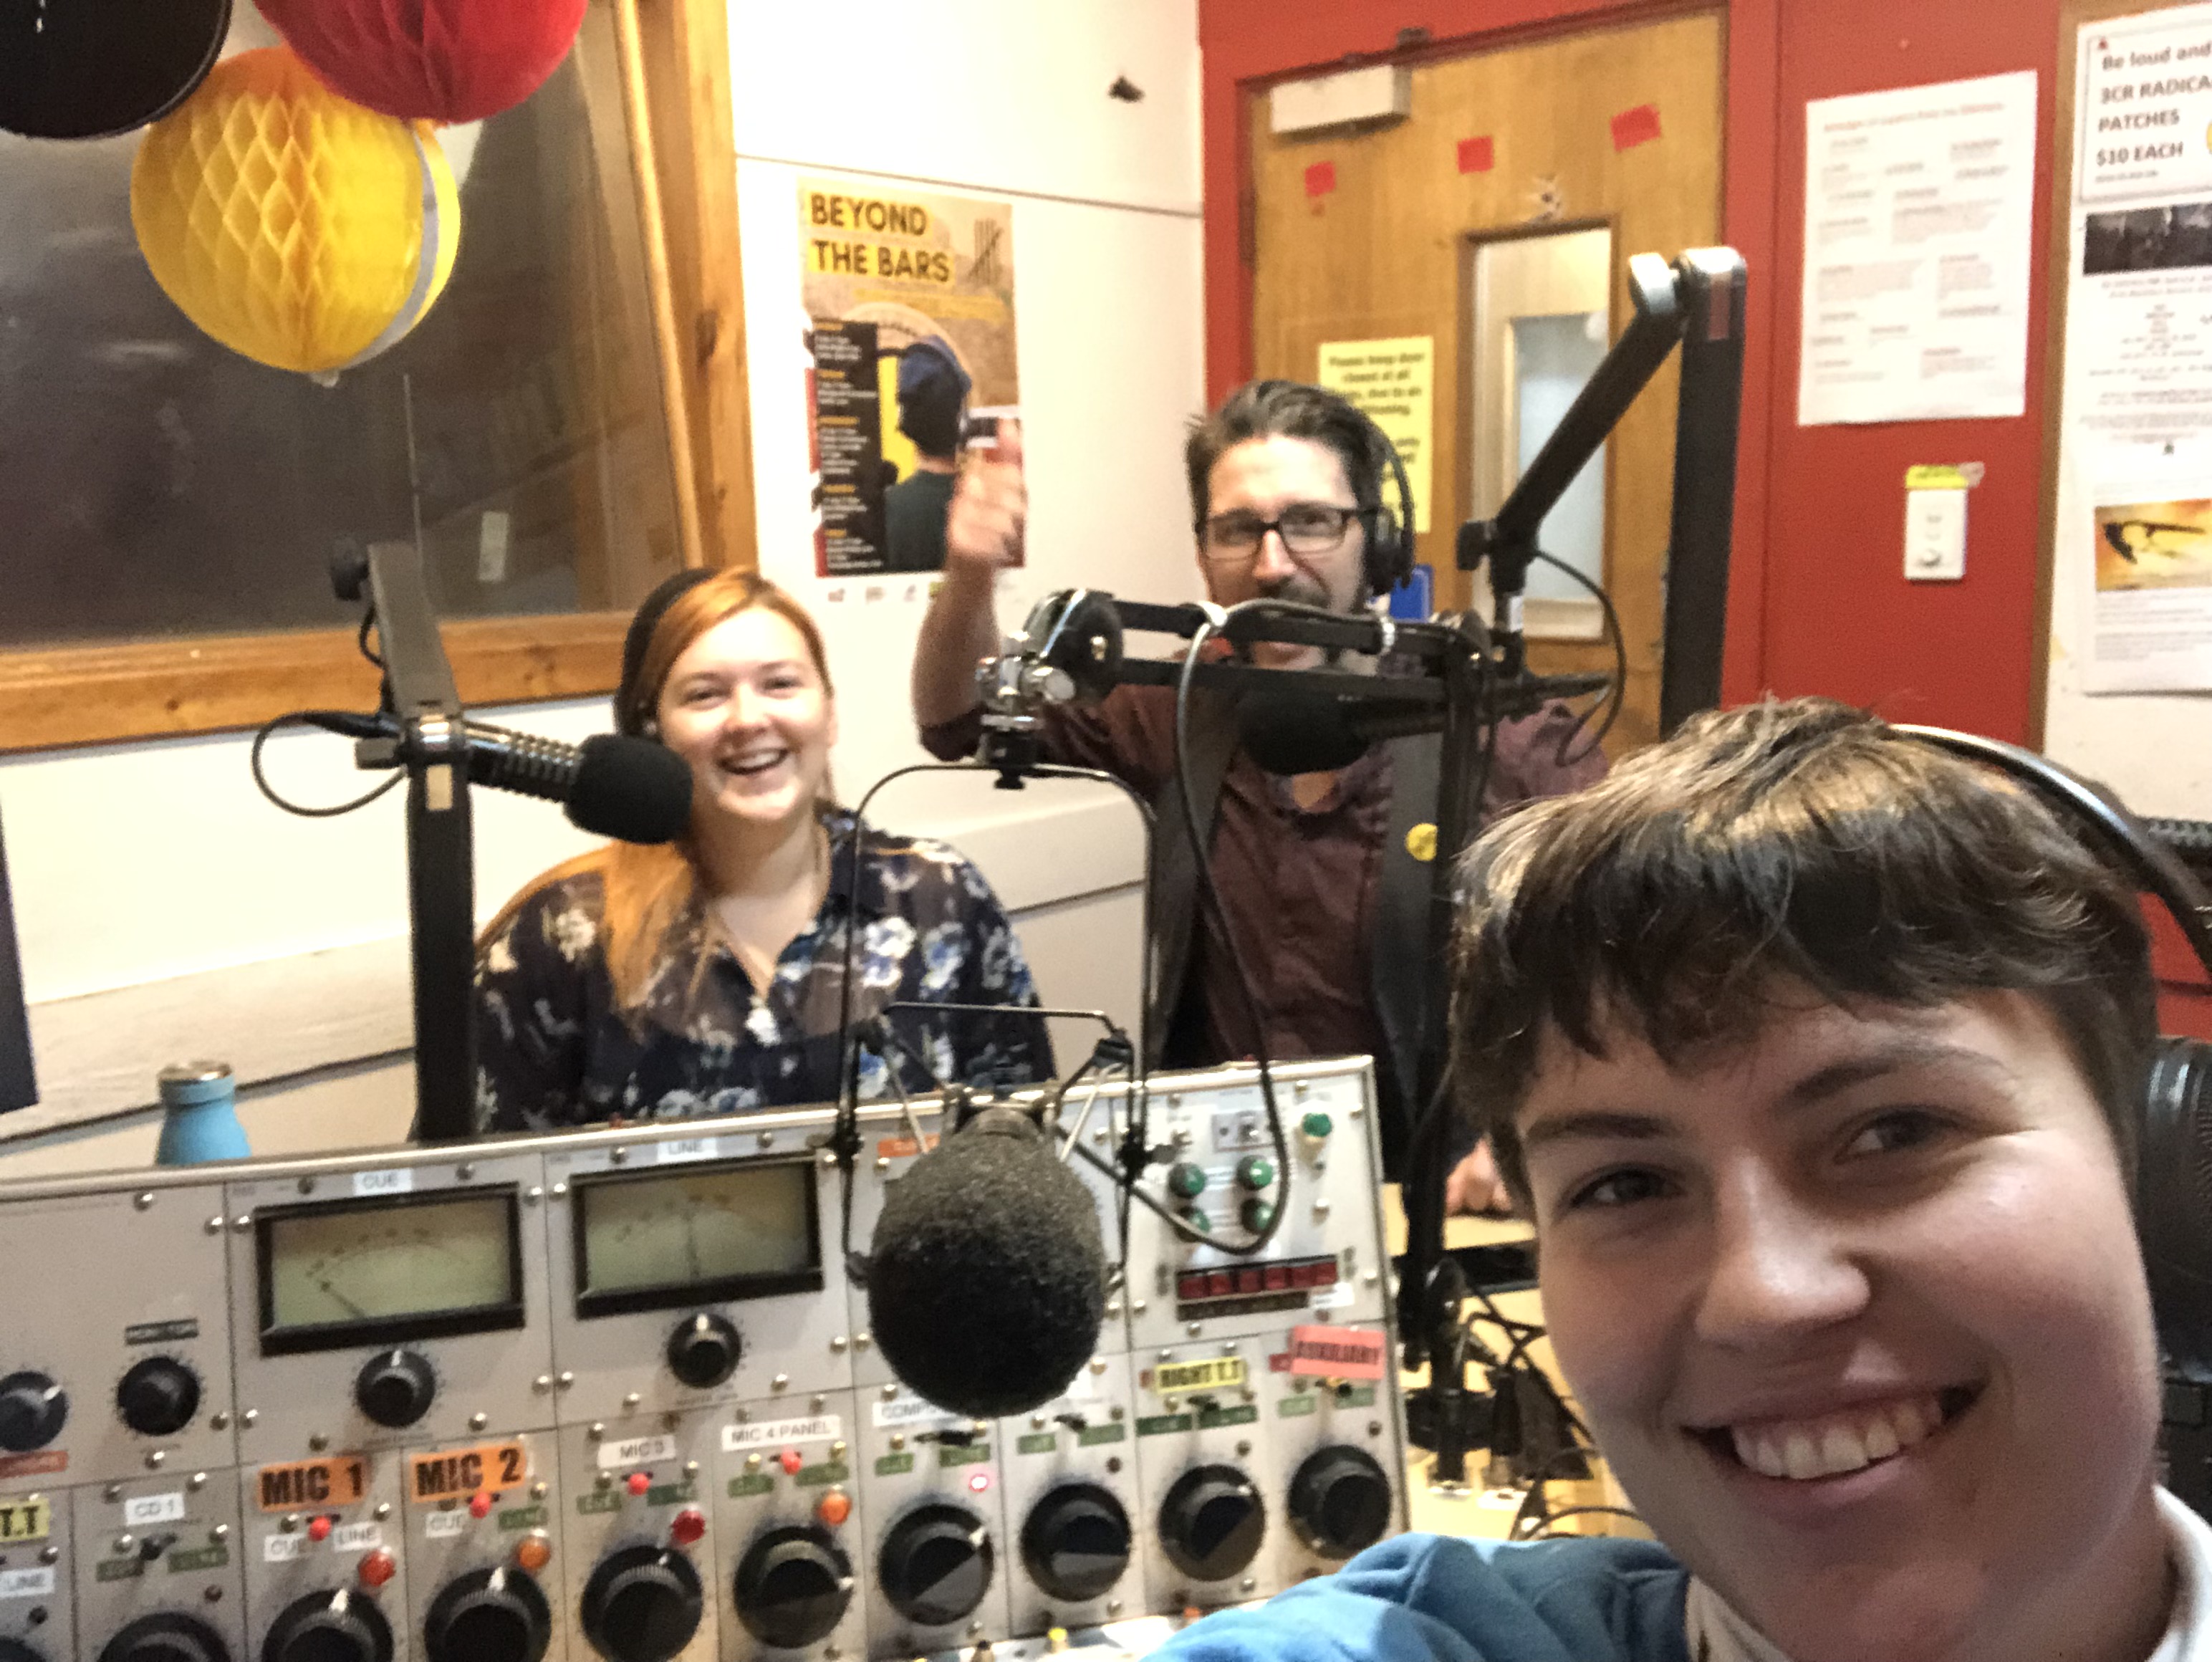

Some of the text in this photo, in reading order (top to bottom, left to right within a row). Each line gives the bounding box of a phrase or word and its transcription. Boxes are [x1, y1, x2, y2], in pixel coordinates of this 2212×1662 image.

[2102, 41, 2212, 71] Be loud and
[2102, 75, 2212, 105] 3CR RADICA
[2099, 108, 2179, 133] PATCHES
[2097, 141, 2183, 167] $10 EACH
[811, 193, 926, 236] BEYOND
[814, 240, 949, 282] THE BARS
[668, 1139, 703, 1154] LINE
[362, 1173, 399, 1189] CUE
[732, 1421, 831, 1444] MIC 4 PANEL
[620, 1442, 650, 1459] MIC
[261, 1462, 363, 1505] MIC 1
[415, 1448, 522, 1496] MIC 2
[135, 1503, 162, 1517] CD
[339, 1526, 378, 1545] LINE
